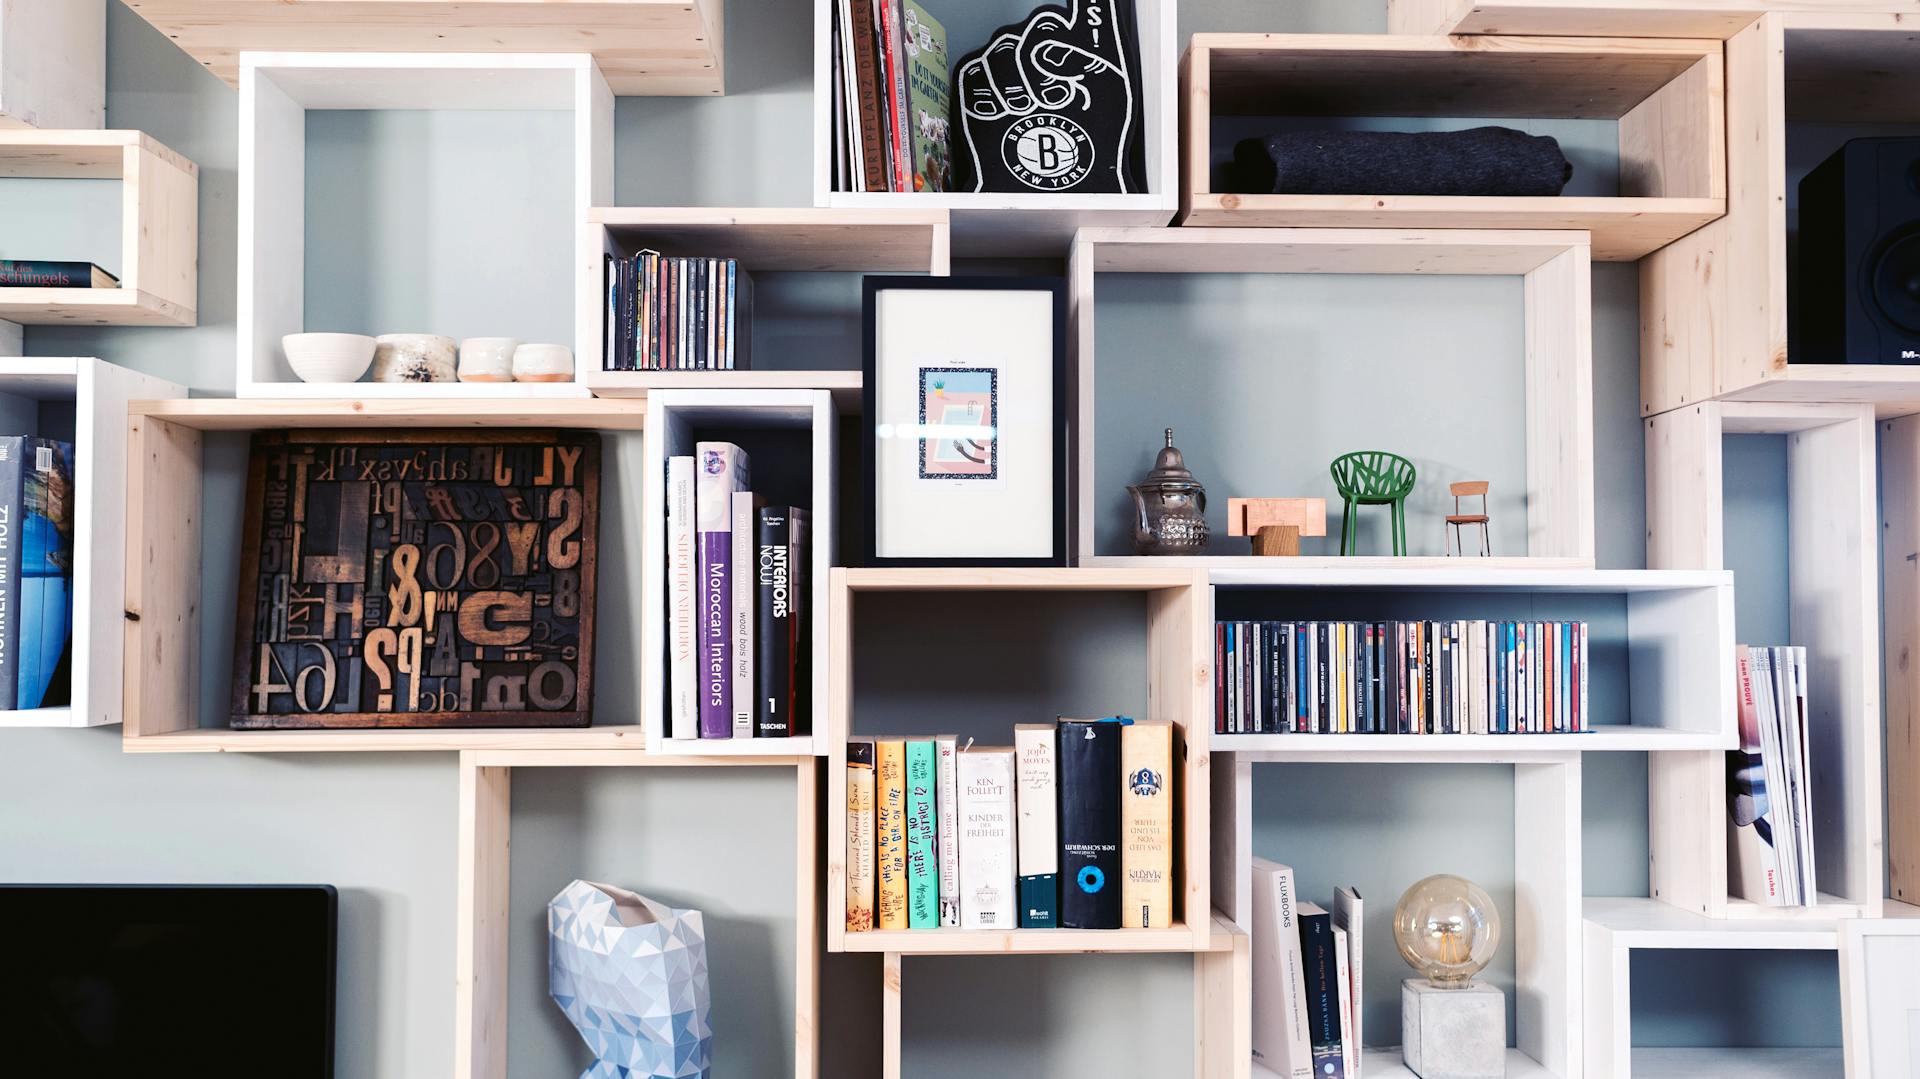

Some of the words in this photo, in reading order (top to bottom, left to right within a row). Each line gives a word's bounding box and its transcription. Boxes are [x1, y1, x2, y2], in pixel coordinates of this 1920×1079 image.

[1008, 116, 1086, 143] BROOKLYN
[1038, 134, 1060, 170] B
[1013, 163, 1043, 186] NEW
[1050, 167, 1087, 188] YORK
[678, 534, 689, 592] DELIGHTS
[760, 545, 774, 585] NOW!
[773, 545, 787, 618] INTERIORS
[710, 563, 725, 637] Moroccan
[679, 594, 689, 661] NORTHERN
[739, 612, 747, 635] wood
[739, 638, 748, 657] bois
[711, 643, 726, 707] Interiors
[739, 660, 748, 678] holz
[768, 698, 776, 713] 1
[1026, 749, 1046, 757] JOJO
[976, 778, 994, 786] KEN
[1142, 771, 1149, 784] 8
[850, 783, 858, 804] Suns
[889, 788, 901, 806] FIRE
[914, 786, 928, 797] 12
[967, 786, 1005, 796] FOLLETT
[879, 806, 889, 831] PLACE
[893, 810, 901, 820] ON
[908, 817, 918, 829] NO
[916, 802, 932, 840] DISTRICT
[968, 814, 1004, 823] KINDER
[849, 808, 861, 846] Splendid
[892, 823, 902, 842] GIRL
[944, 812, 952, 840] home
[967, 829, 1005, 838] FREIHEIT
[1130, 827, 1149, 835] UND
[880, 836, 889, 846] NO
[909, 836, 919, 845] IS
[945, 841, 953, 856] me
[850, 848, 862, 885] Thousand
[862, 839, 870, 877] KHALED
[881, 853, 889, 861] IS
[894, 857, 903, 872] FOR
[910, 850, 927, 878] THERE
[882, 865, 893, 883] THIS
[944, 858, 954, 892] calling
[1129, 868, 1162, 879] MARTIN
[1768, 869, 1776, 897] Taschen
[852, 886, 861, 895] A
[881, 888, 894, 922] CATCHING
[892, 895, 903, 911] FIRE
[915, 883, 929, 921] MOCKINGJAY
[1279, 875, 1291, 929] FLUXBOOKS
